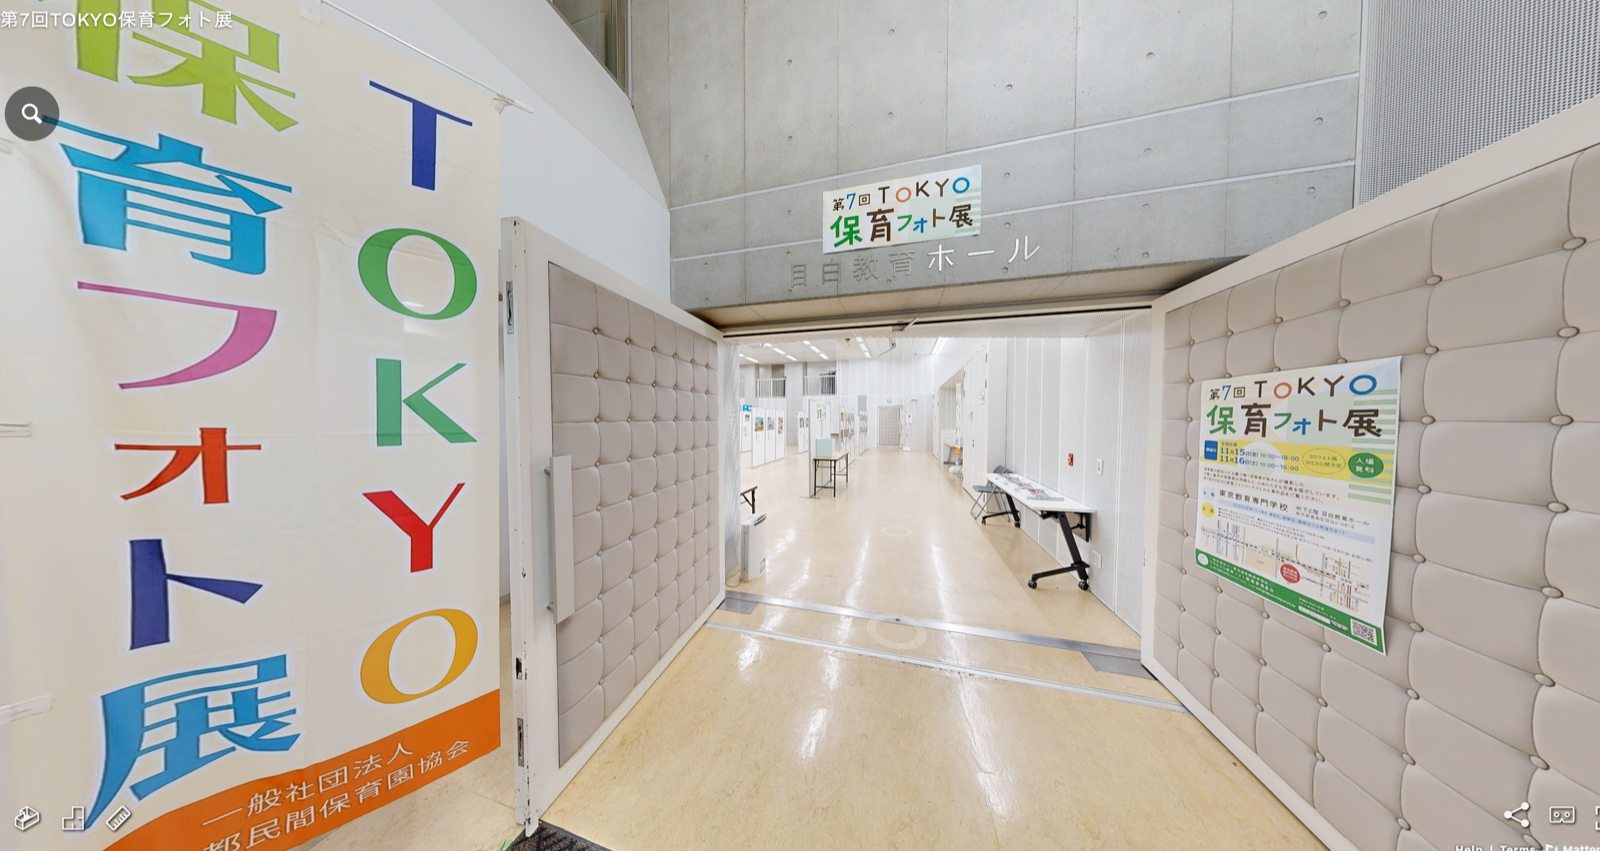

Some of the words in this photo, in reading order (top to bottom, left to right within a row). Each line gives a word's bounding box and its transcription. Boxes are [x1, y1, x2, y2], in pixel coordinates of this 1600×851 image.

[832, 192, 871, 212] 第7回
[878, 177, 970, 204] TOKYO
[830, 203, 974, 248] 保育フォト展
[790, 235, 1041, 289] 目白教育ホール
[357, 79, 479, 705] TOKYO
[1209, 385, 1246, 401] 第7回
[1254, 374, 1378, 400] TOKYO
[40, 0, 301, 829] 保育フォト展
[1206, 402, 1383, 438] 保育フォト展
[1218, 489, 1289, 513] 東京教育専門学校
[201, 742, 414, 828] 一般社団法人
[203, 739, 471, 851] 都民間保育園協会
